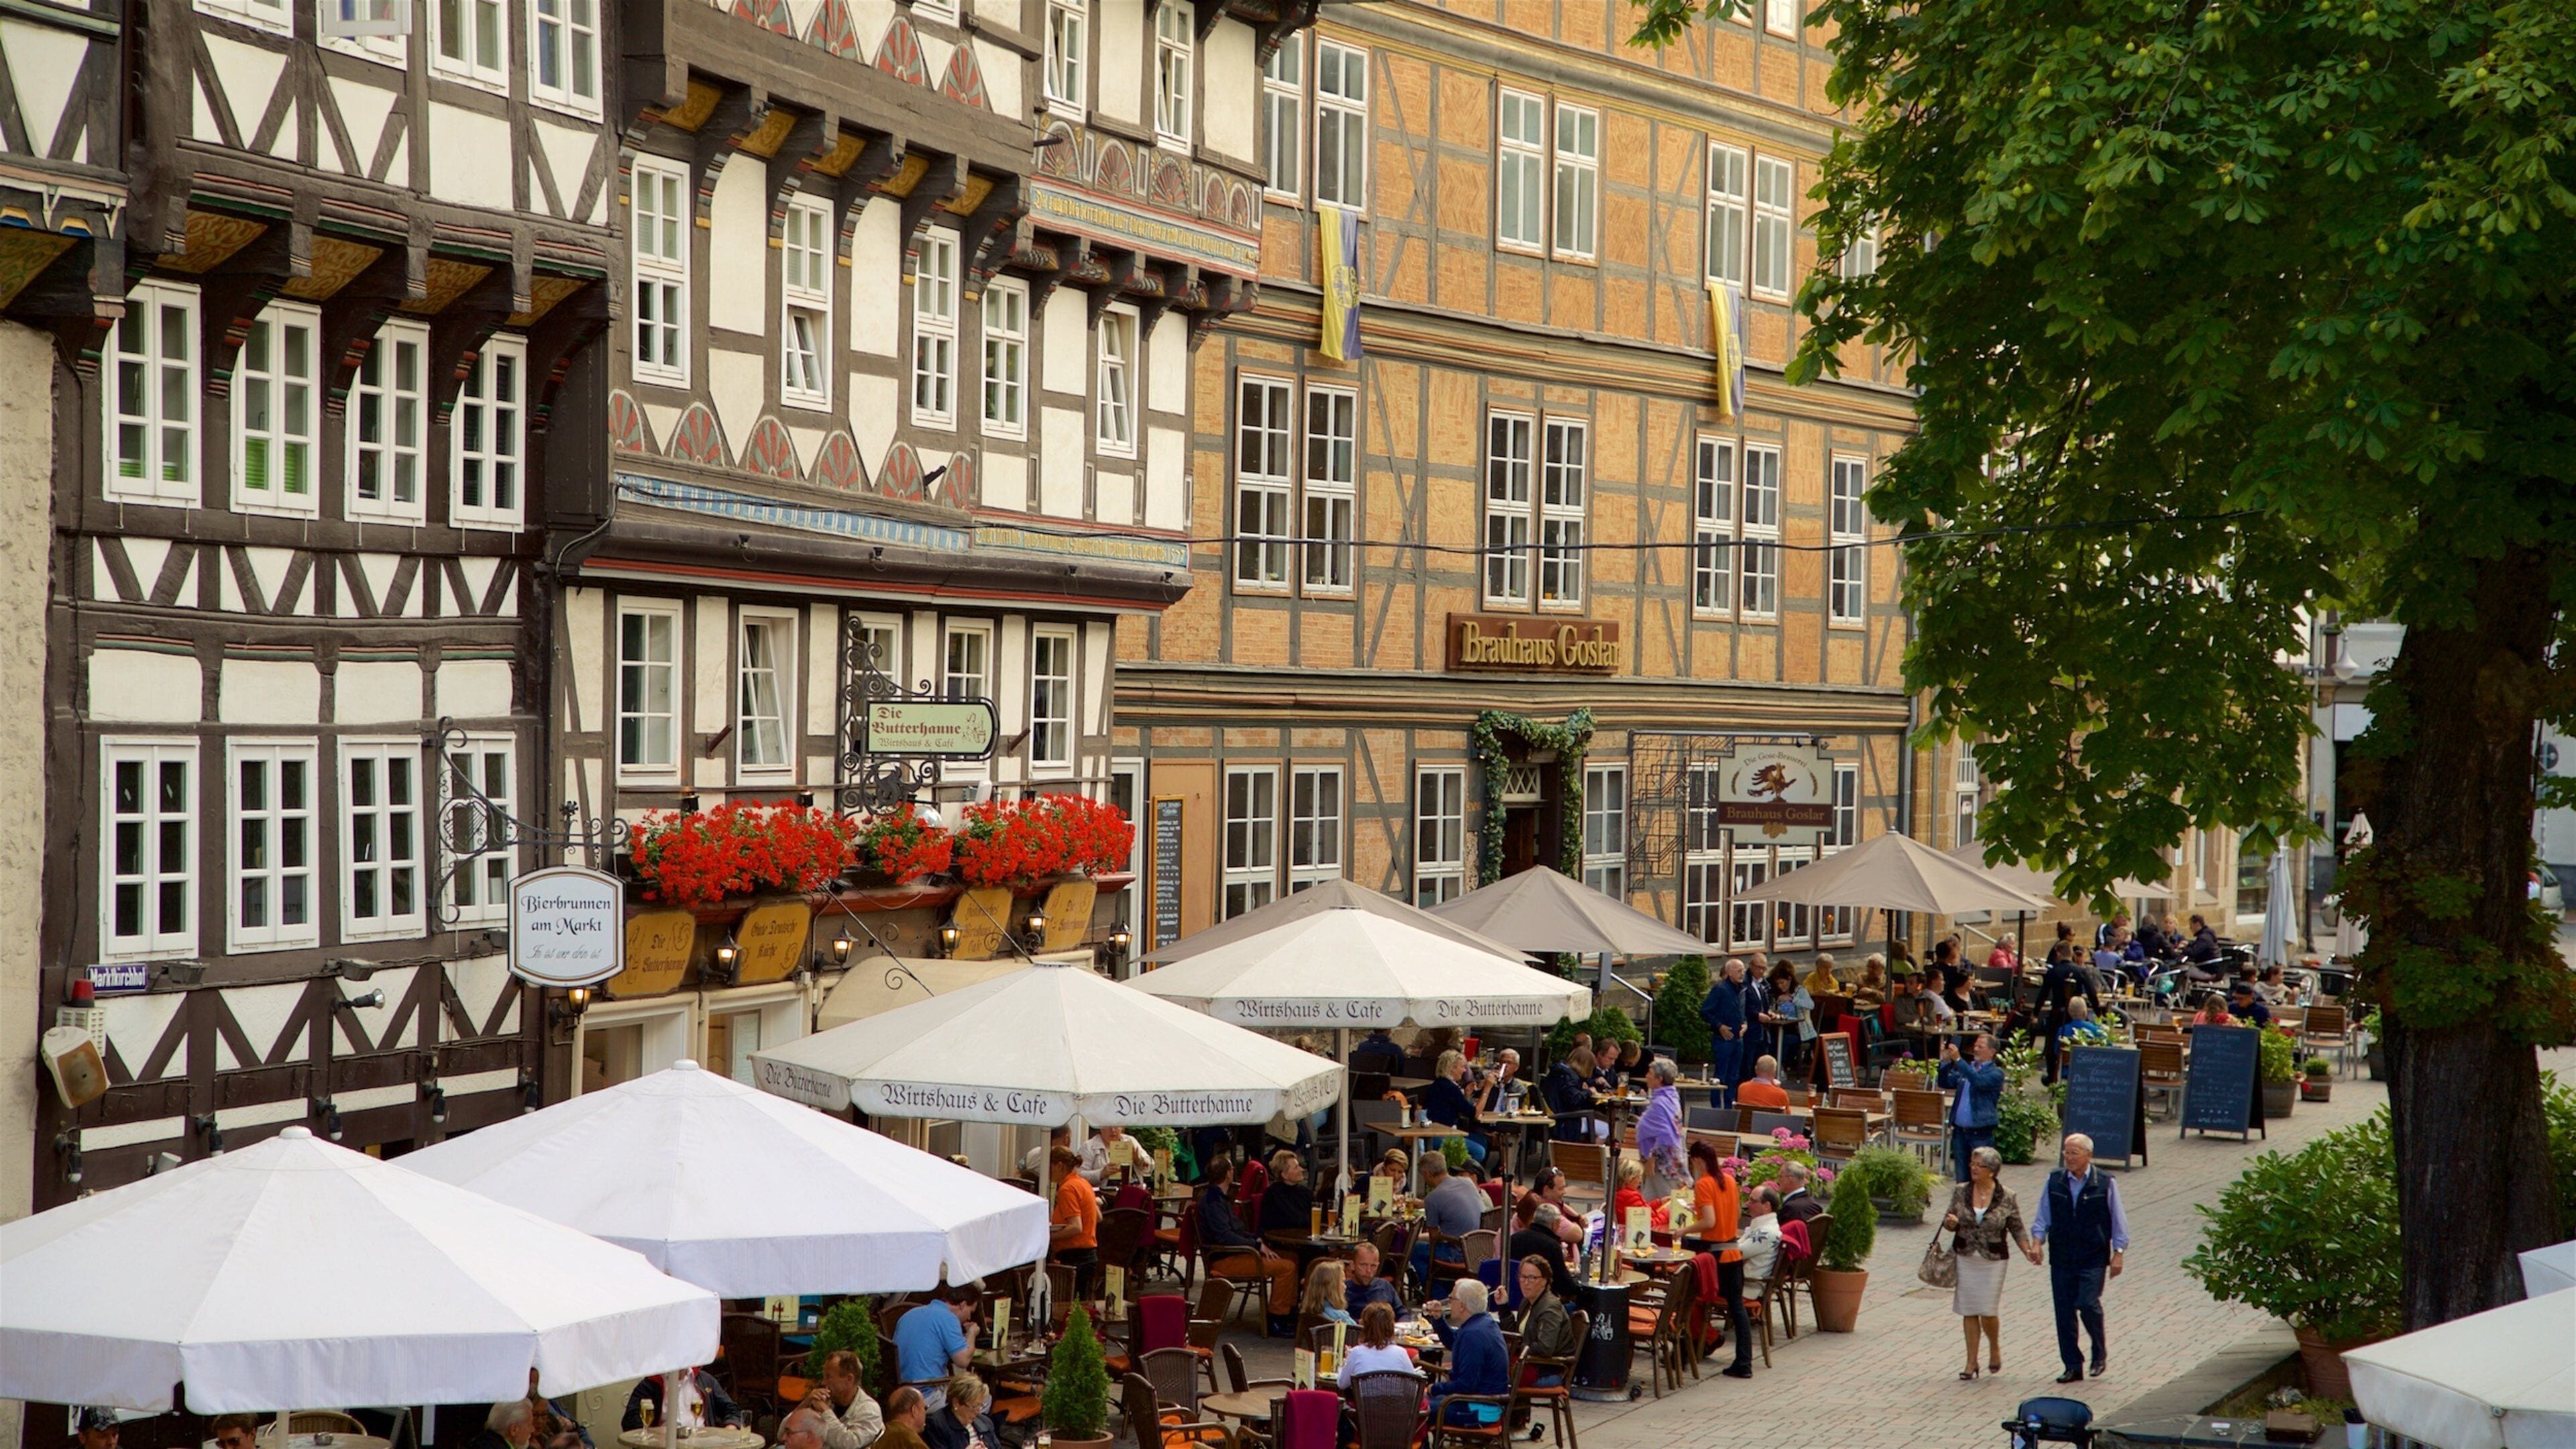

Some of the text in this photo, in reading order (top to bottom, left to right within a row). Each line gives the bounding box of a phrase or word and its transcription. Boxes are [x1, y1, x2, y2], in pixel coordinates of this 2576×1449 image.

[1460, 621, 1620, 667] Brauhaus Goslar
[876, 706, 902, 718] Die
[871, 721, 961, 737] Butterhanne
[877, 737, 922, 748] Wirtshaus
[924, 739, 932, 747] &
[1743, 756, 1758, 767] Die
[1726, 806, 1825, 820] Brauhaus Goslar
[521, 895, 611, 914] Bierbrunnen
[531, 917, 602, 936] am Markt
[90, 967, 146, 987] Marktkirchhof
[1235, 1000, 1383, 1022] Wirtshaus & Cafe
[1436, 999, 1543, 1019] Die Butterhanne
[765, 1063, 782, 1085] Die
[880, 1083, 1047, 1118] Wirtshaus & Cafe
[1113, 1093, 1253, 1118] Die Butterhanne
